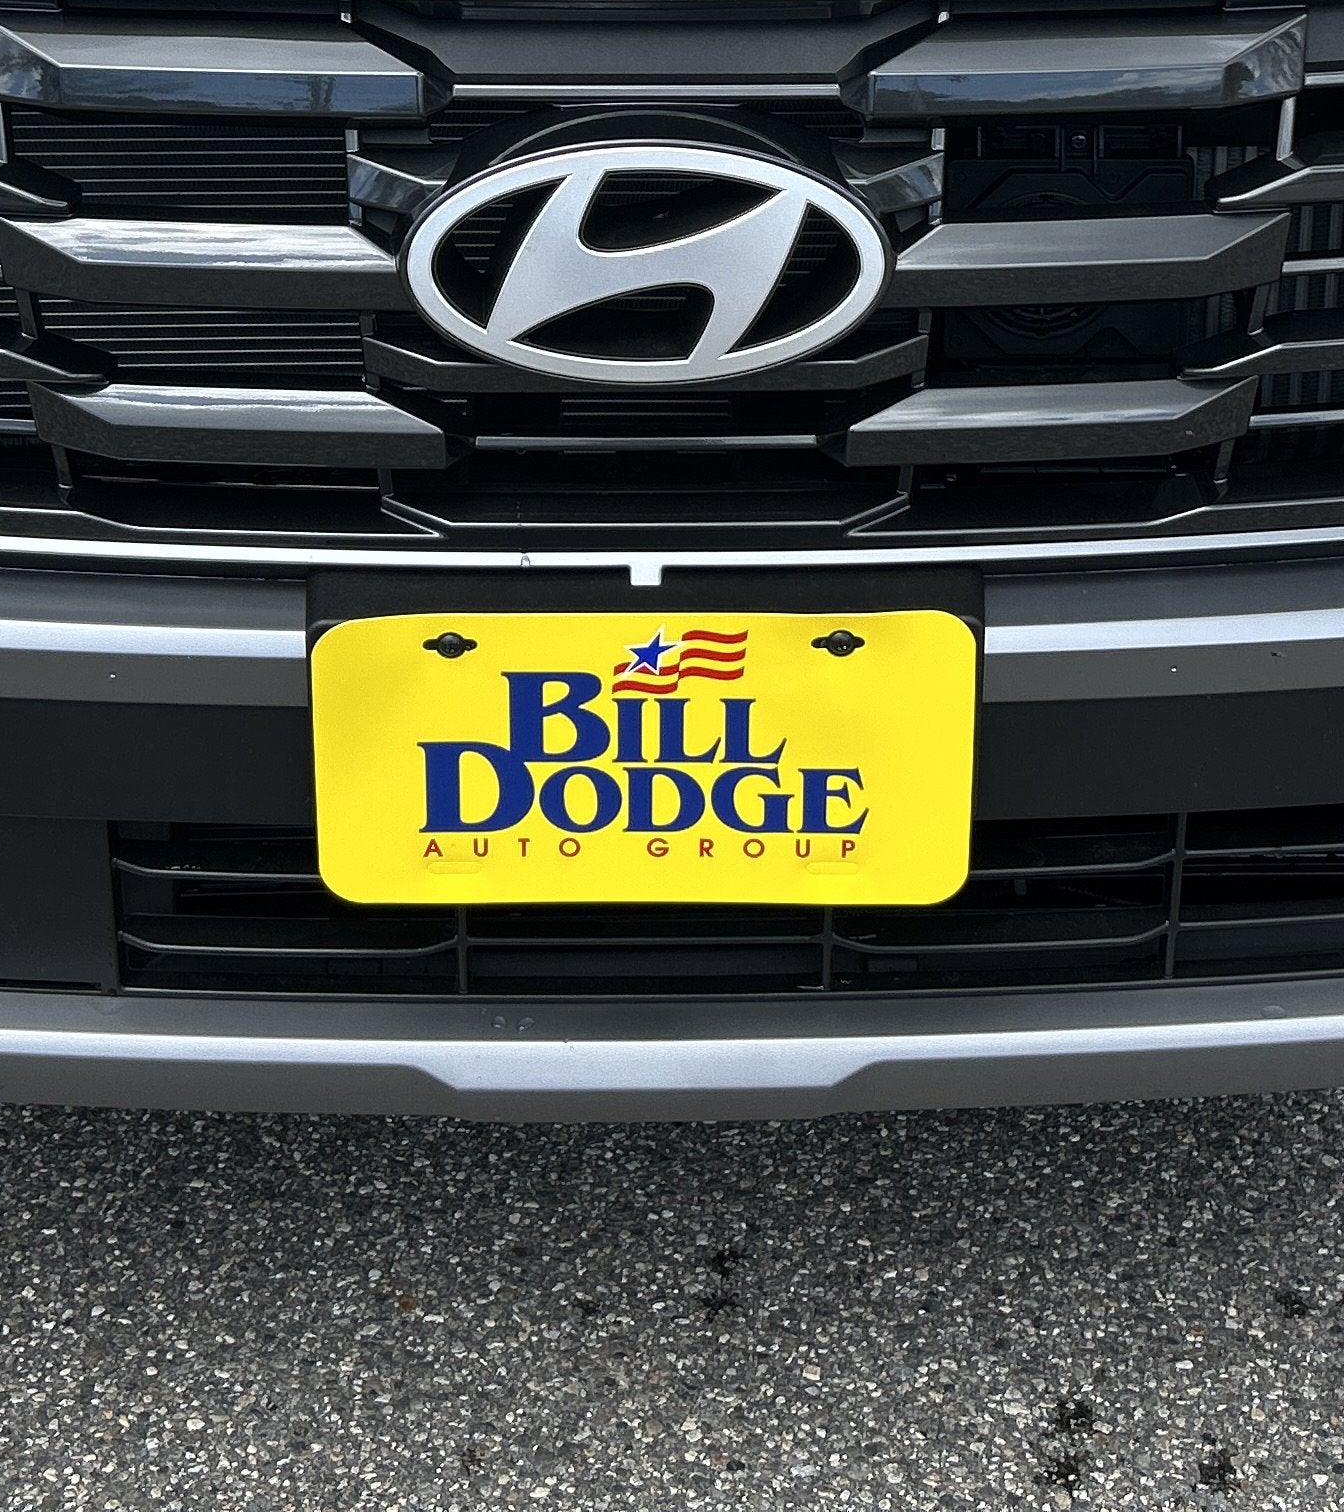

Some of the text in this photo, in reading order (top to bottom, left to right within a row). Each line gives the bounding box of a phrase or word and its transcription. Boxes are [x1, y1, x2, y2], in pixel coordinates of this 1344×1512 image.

[500, 670, 788, 764] BILL
[416, 741, 870, 835] DODGE
[422, 837, 856, 858] AUTO GROUP
